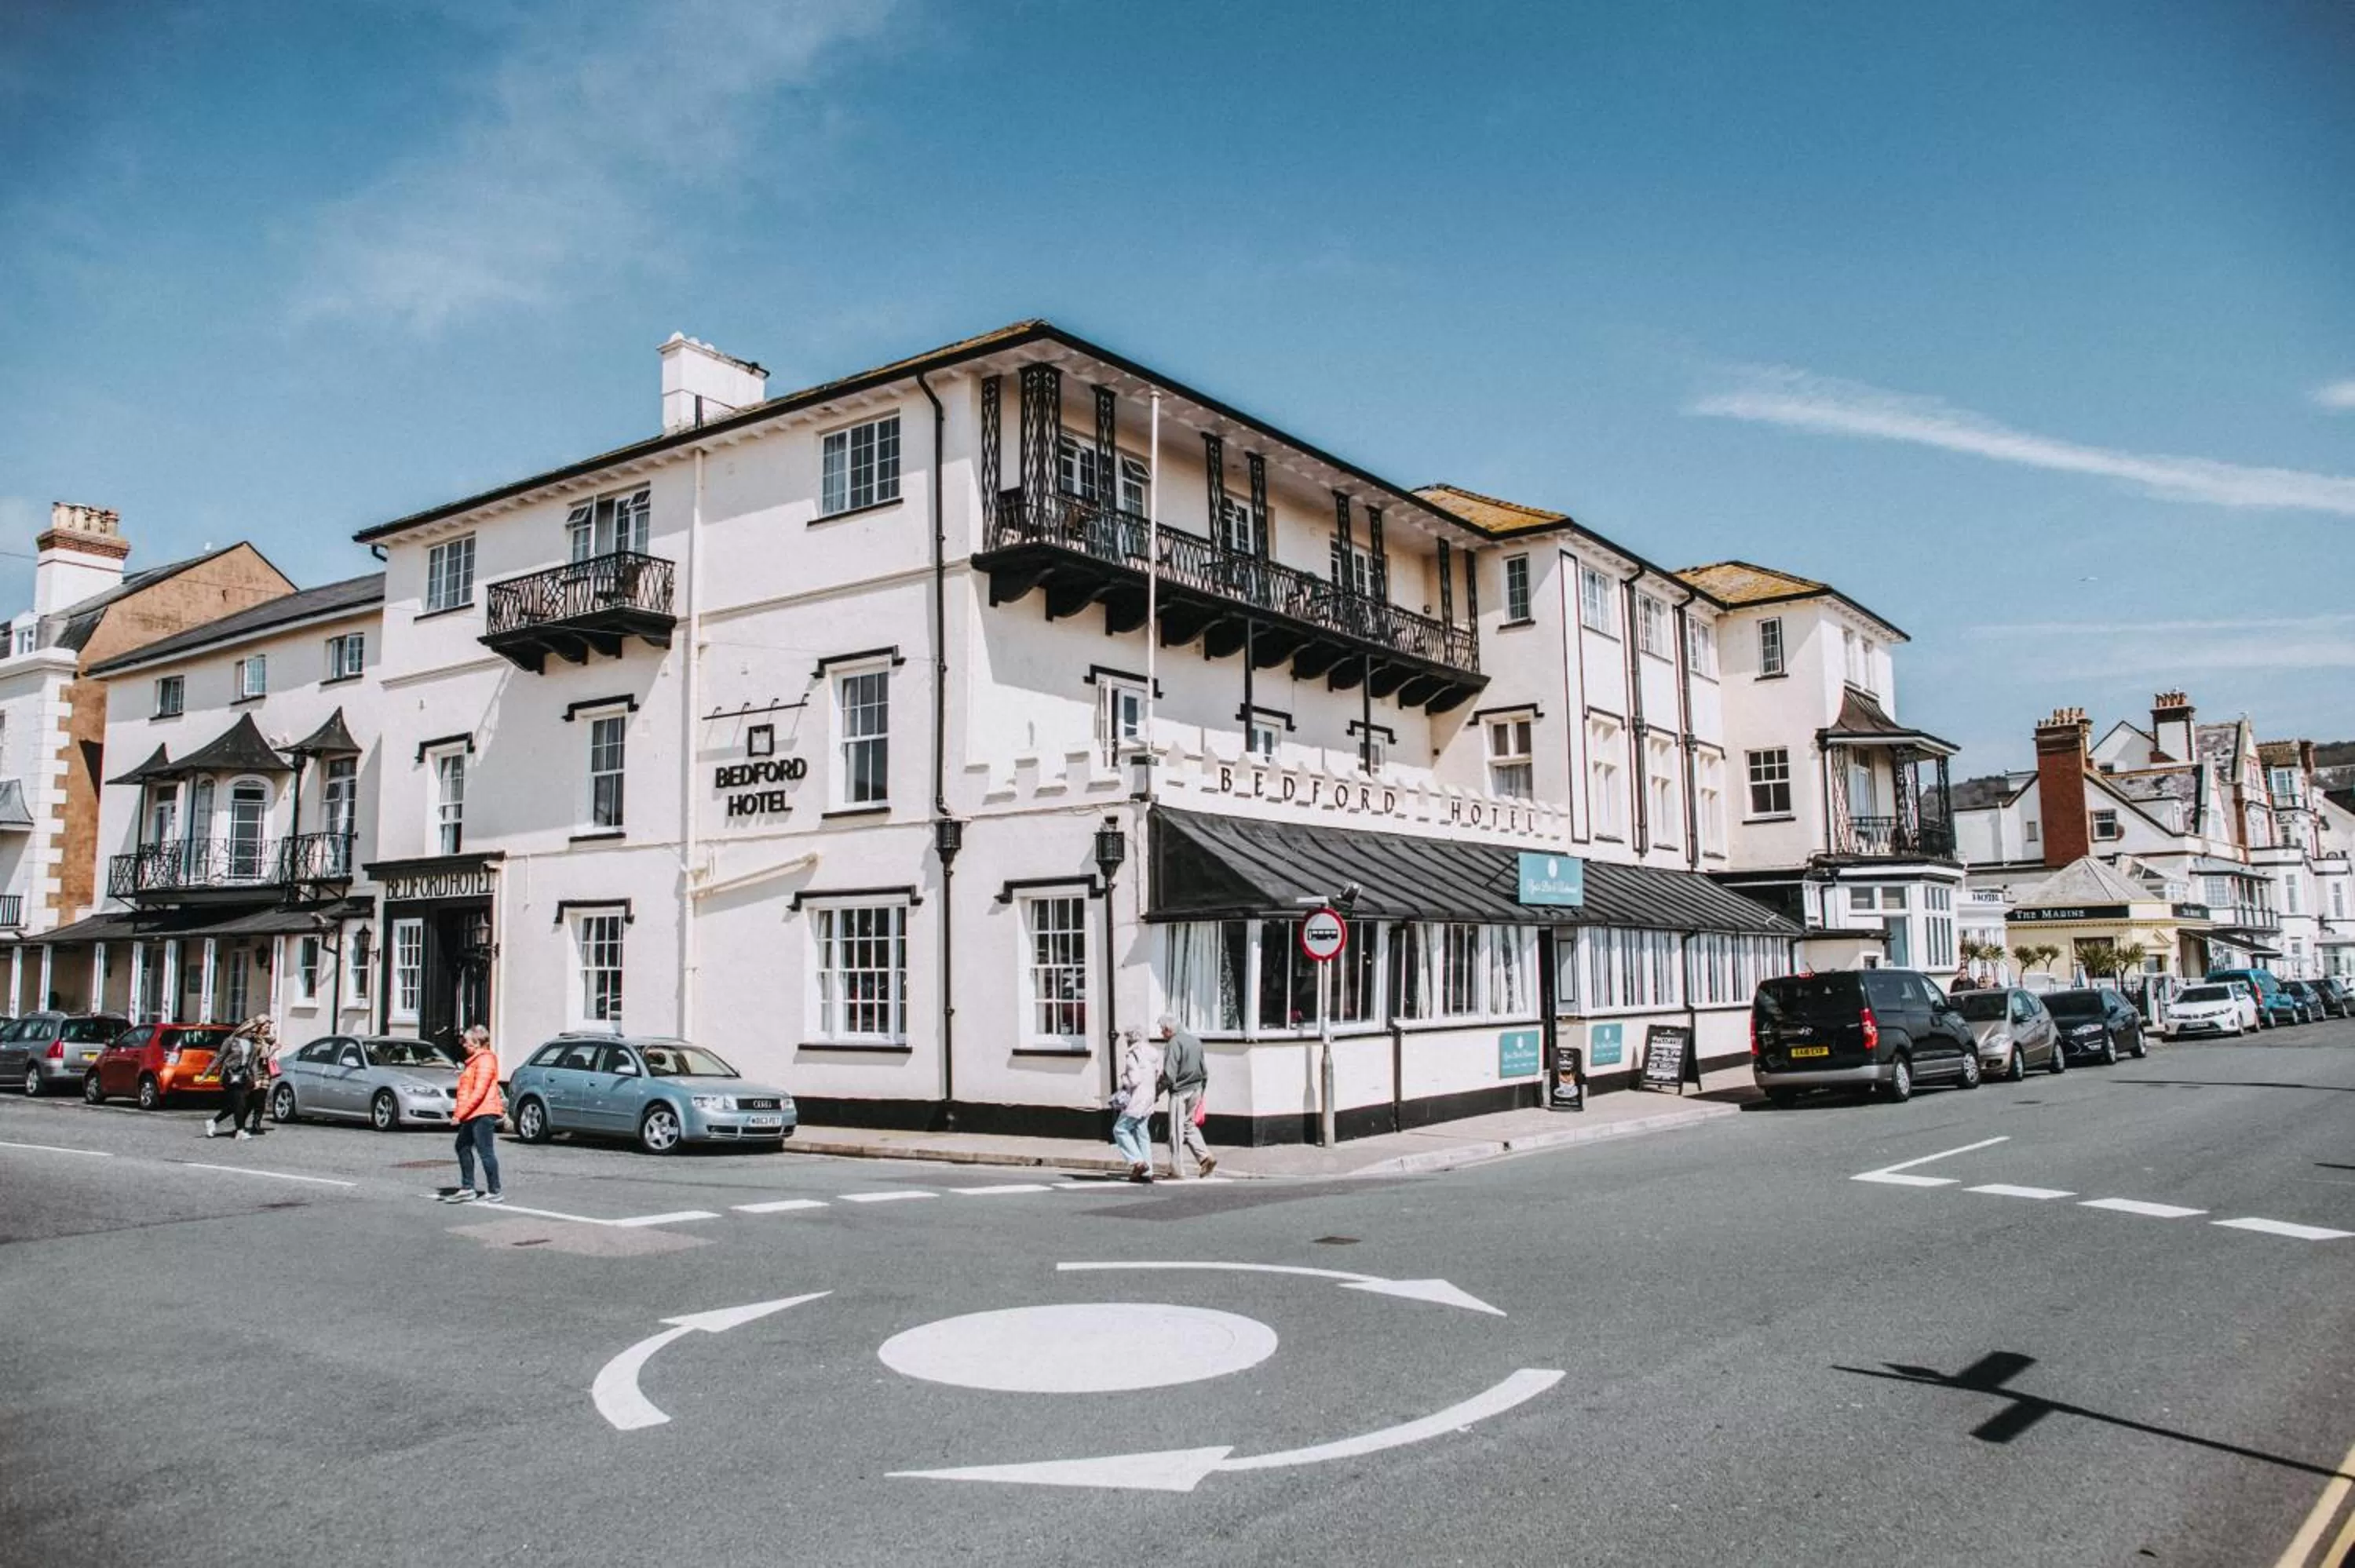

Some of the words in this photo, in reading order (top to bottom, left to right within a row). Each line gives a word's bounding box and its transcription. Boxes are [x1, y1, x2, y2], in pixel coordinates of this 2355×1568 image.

[715, 758, 807, 788] BEDFORD
[728, 790, 793, 816] HOTEL
[1220, 766, 1395, 814] BEDFORD
[1451, 800, 1534, 833] HOTEL
[385, 871, 447, 899] BEDFORD
[450, 869, 495, 895] HOTEL
[2015, 910, 2037, 920] THE
